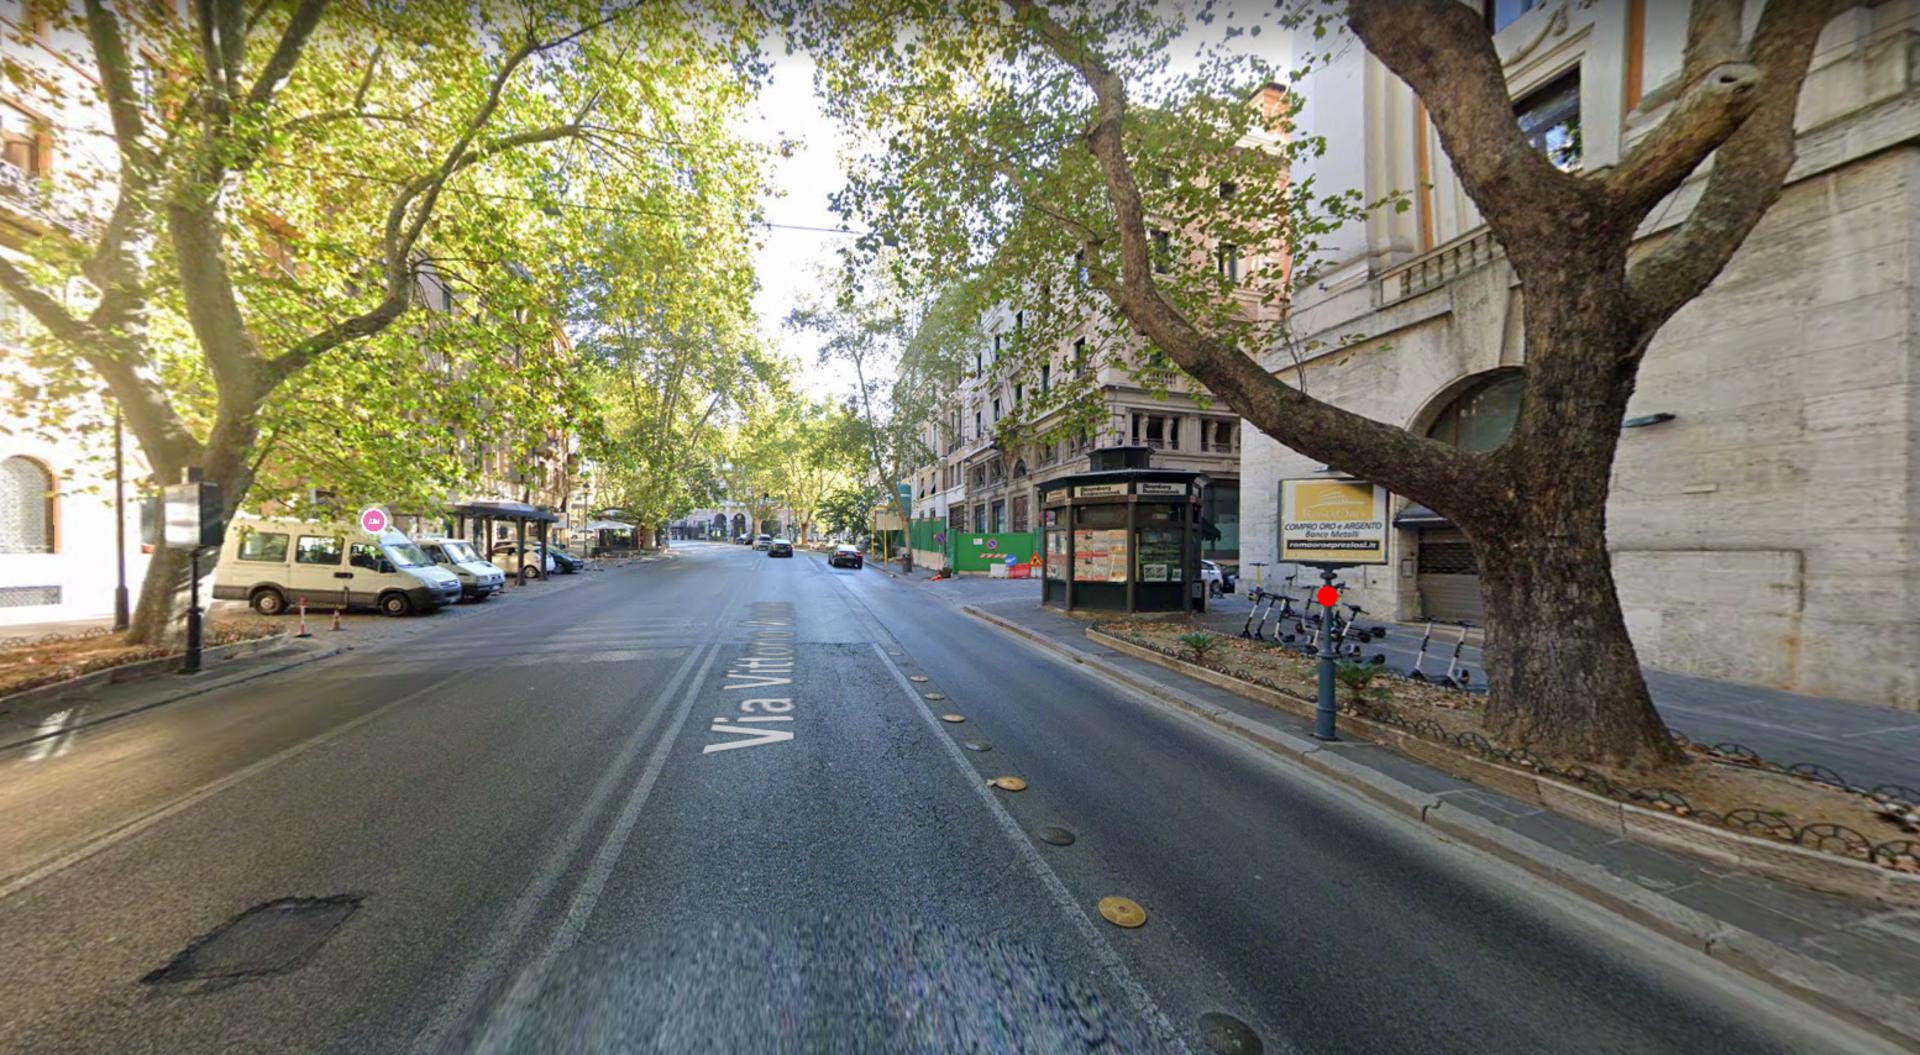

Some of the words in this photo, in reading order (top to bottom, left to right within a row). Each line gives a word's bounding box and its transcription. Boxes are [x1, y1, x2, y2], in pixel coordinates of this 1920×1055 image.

[1284, 522, 1318, 531] COMPRO
[1319, 522, 1336, 530] ORO
[1343, 521, 1383, 530] ARGENTO
